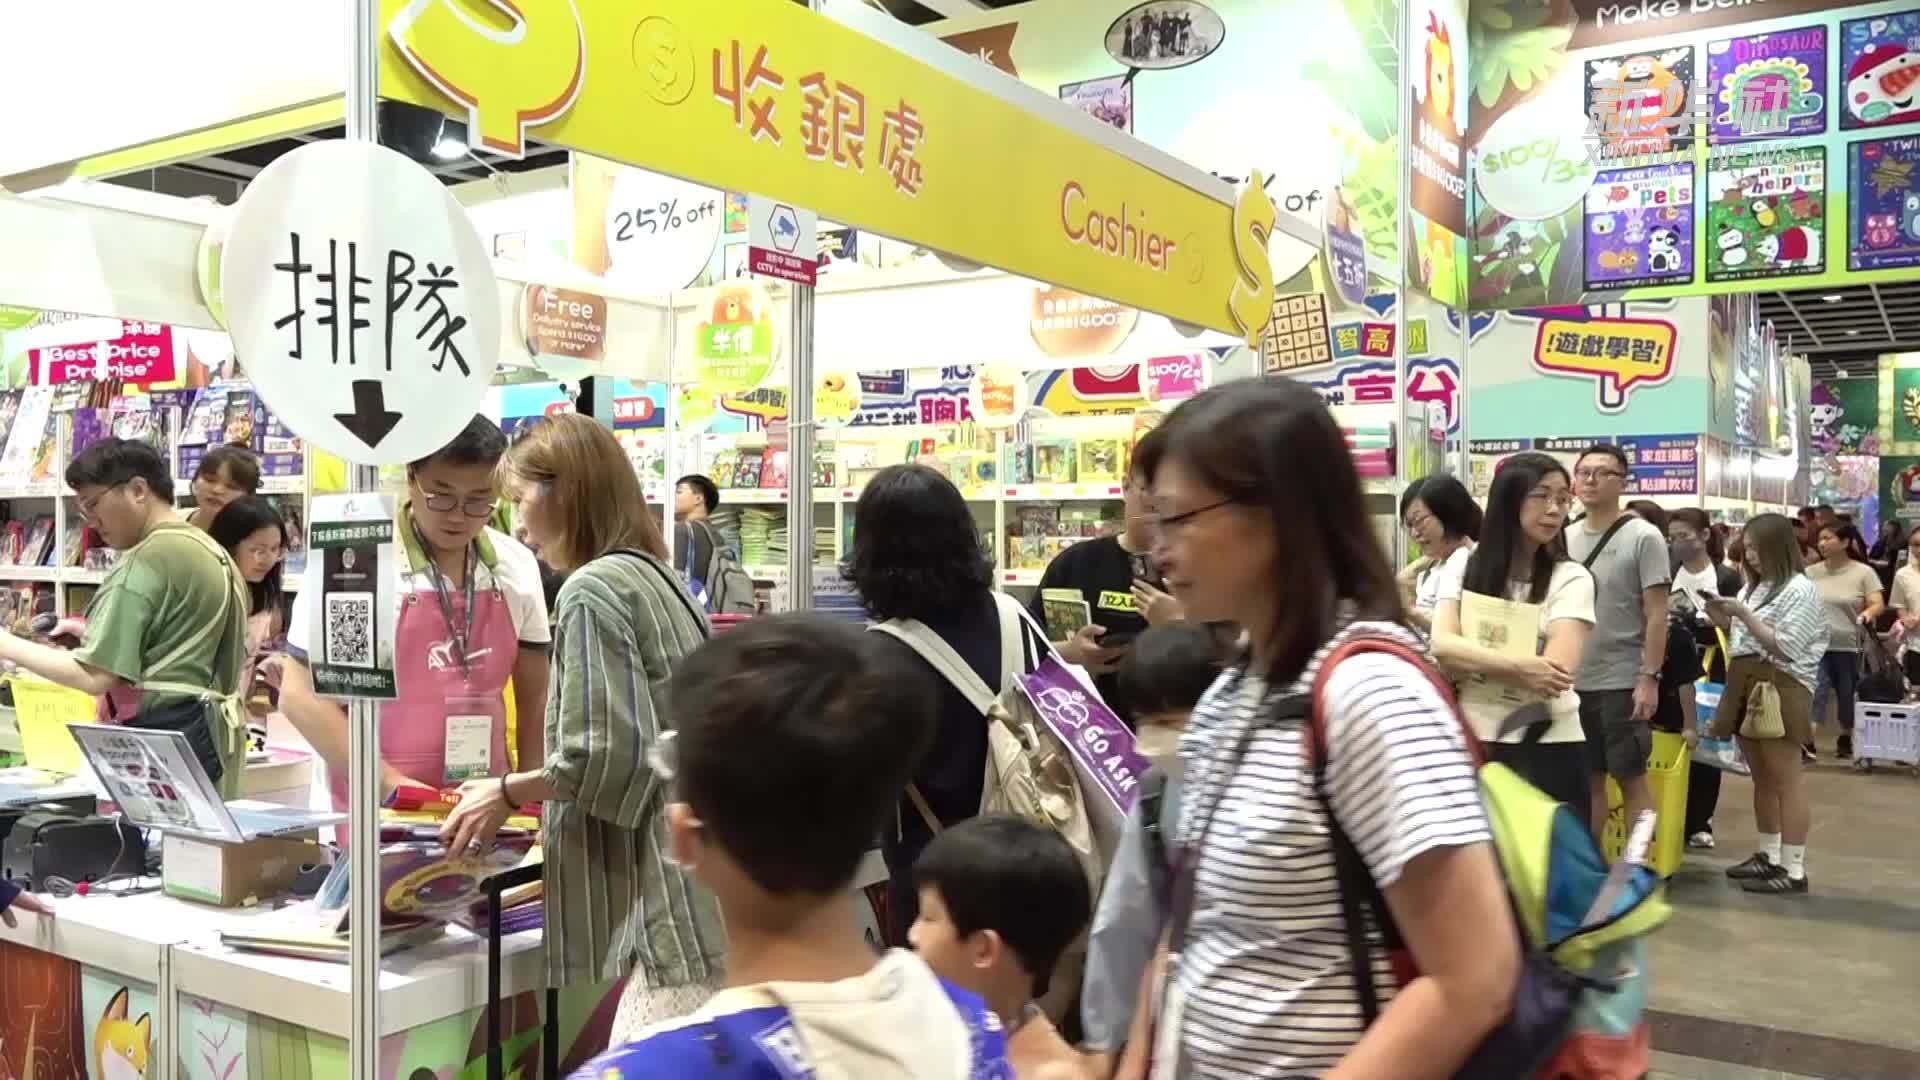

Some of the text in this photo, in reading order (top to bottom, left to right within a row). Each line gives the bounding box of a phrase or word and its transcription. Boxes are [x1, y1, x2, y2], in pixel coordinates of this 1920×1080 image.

[1595, 0, 1683, 28] Make
[710, 38, 926, 199] 收銀處
[1639, 184, 1690, 208] pets
[614, 199, 682, 242] 25%
[1061, 180, 1178, 272] Cashier
[274, 231, 472, 377] 排隊
[543, 290, 594, 319] Free
[49, 342, 161, 362] Best Price
[1084, 725, 1109, 754] GO
[1103, 755, 1139, 793] ASK
